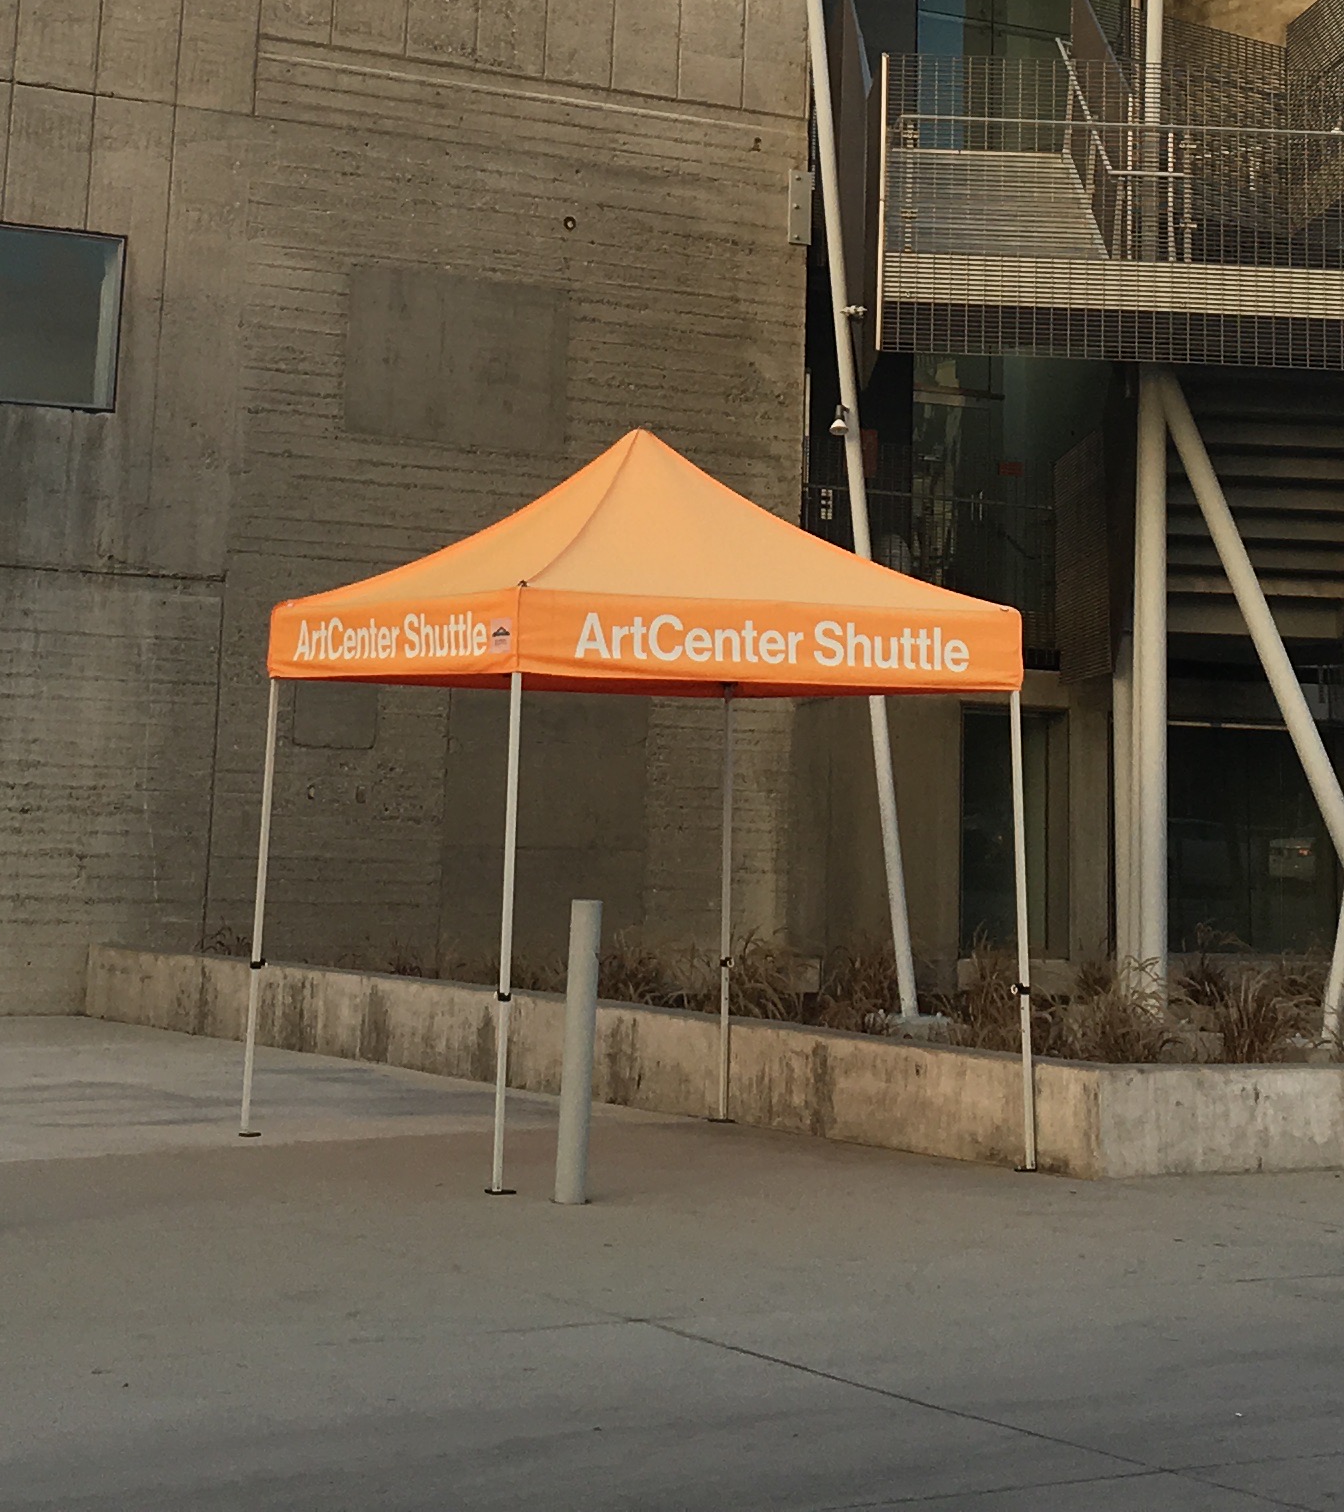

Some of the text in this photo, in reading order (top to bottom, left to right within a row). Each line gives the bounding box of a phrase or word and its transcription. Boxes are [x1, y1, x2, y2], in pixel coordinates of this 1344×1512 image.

[293, 610, 488, 661] ArtCenter Shuttle
[574, 612, 970, 673] ArtCenter Shuttle
